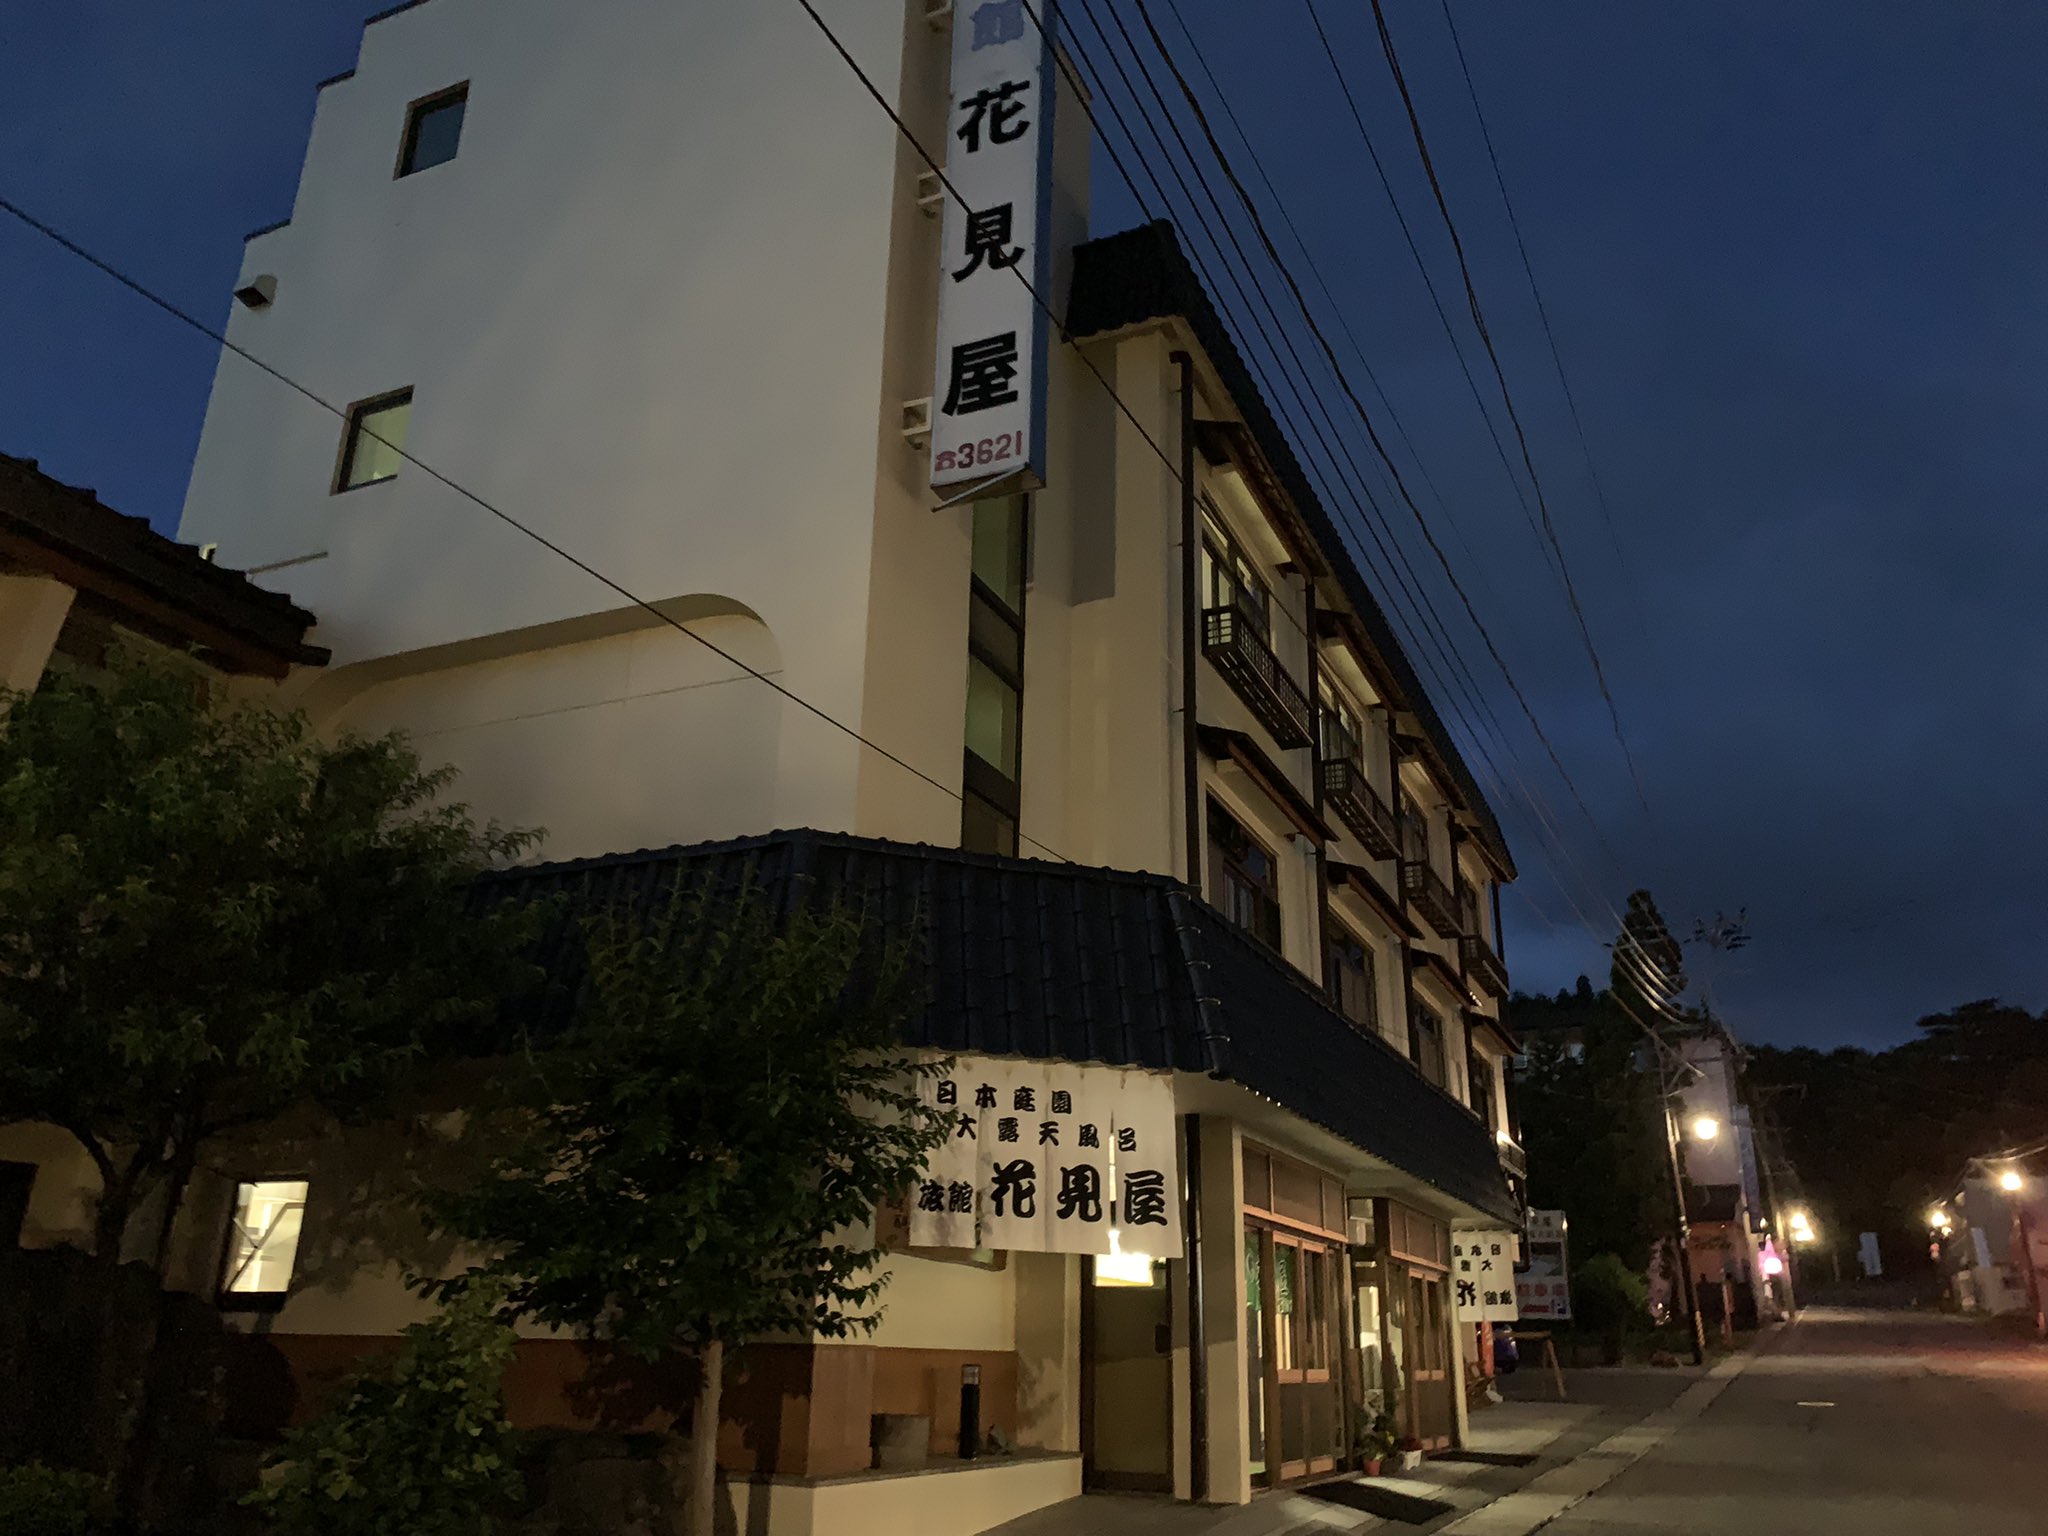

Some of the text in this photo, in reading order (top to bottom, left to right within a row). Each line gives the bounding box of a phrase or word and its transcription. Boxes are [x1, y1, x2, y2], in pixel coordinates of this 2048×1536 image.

[941, 80, 1031, 418] 花見屋
[957, 430, 1023, 470] 3621
[956, 1113, 1138, 1153] 大露天風呂
[991, 1159, 1168, 1226] 花見屋
